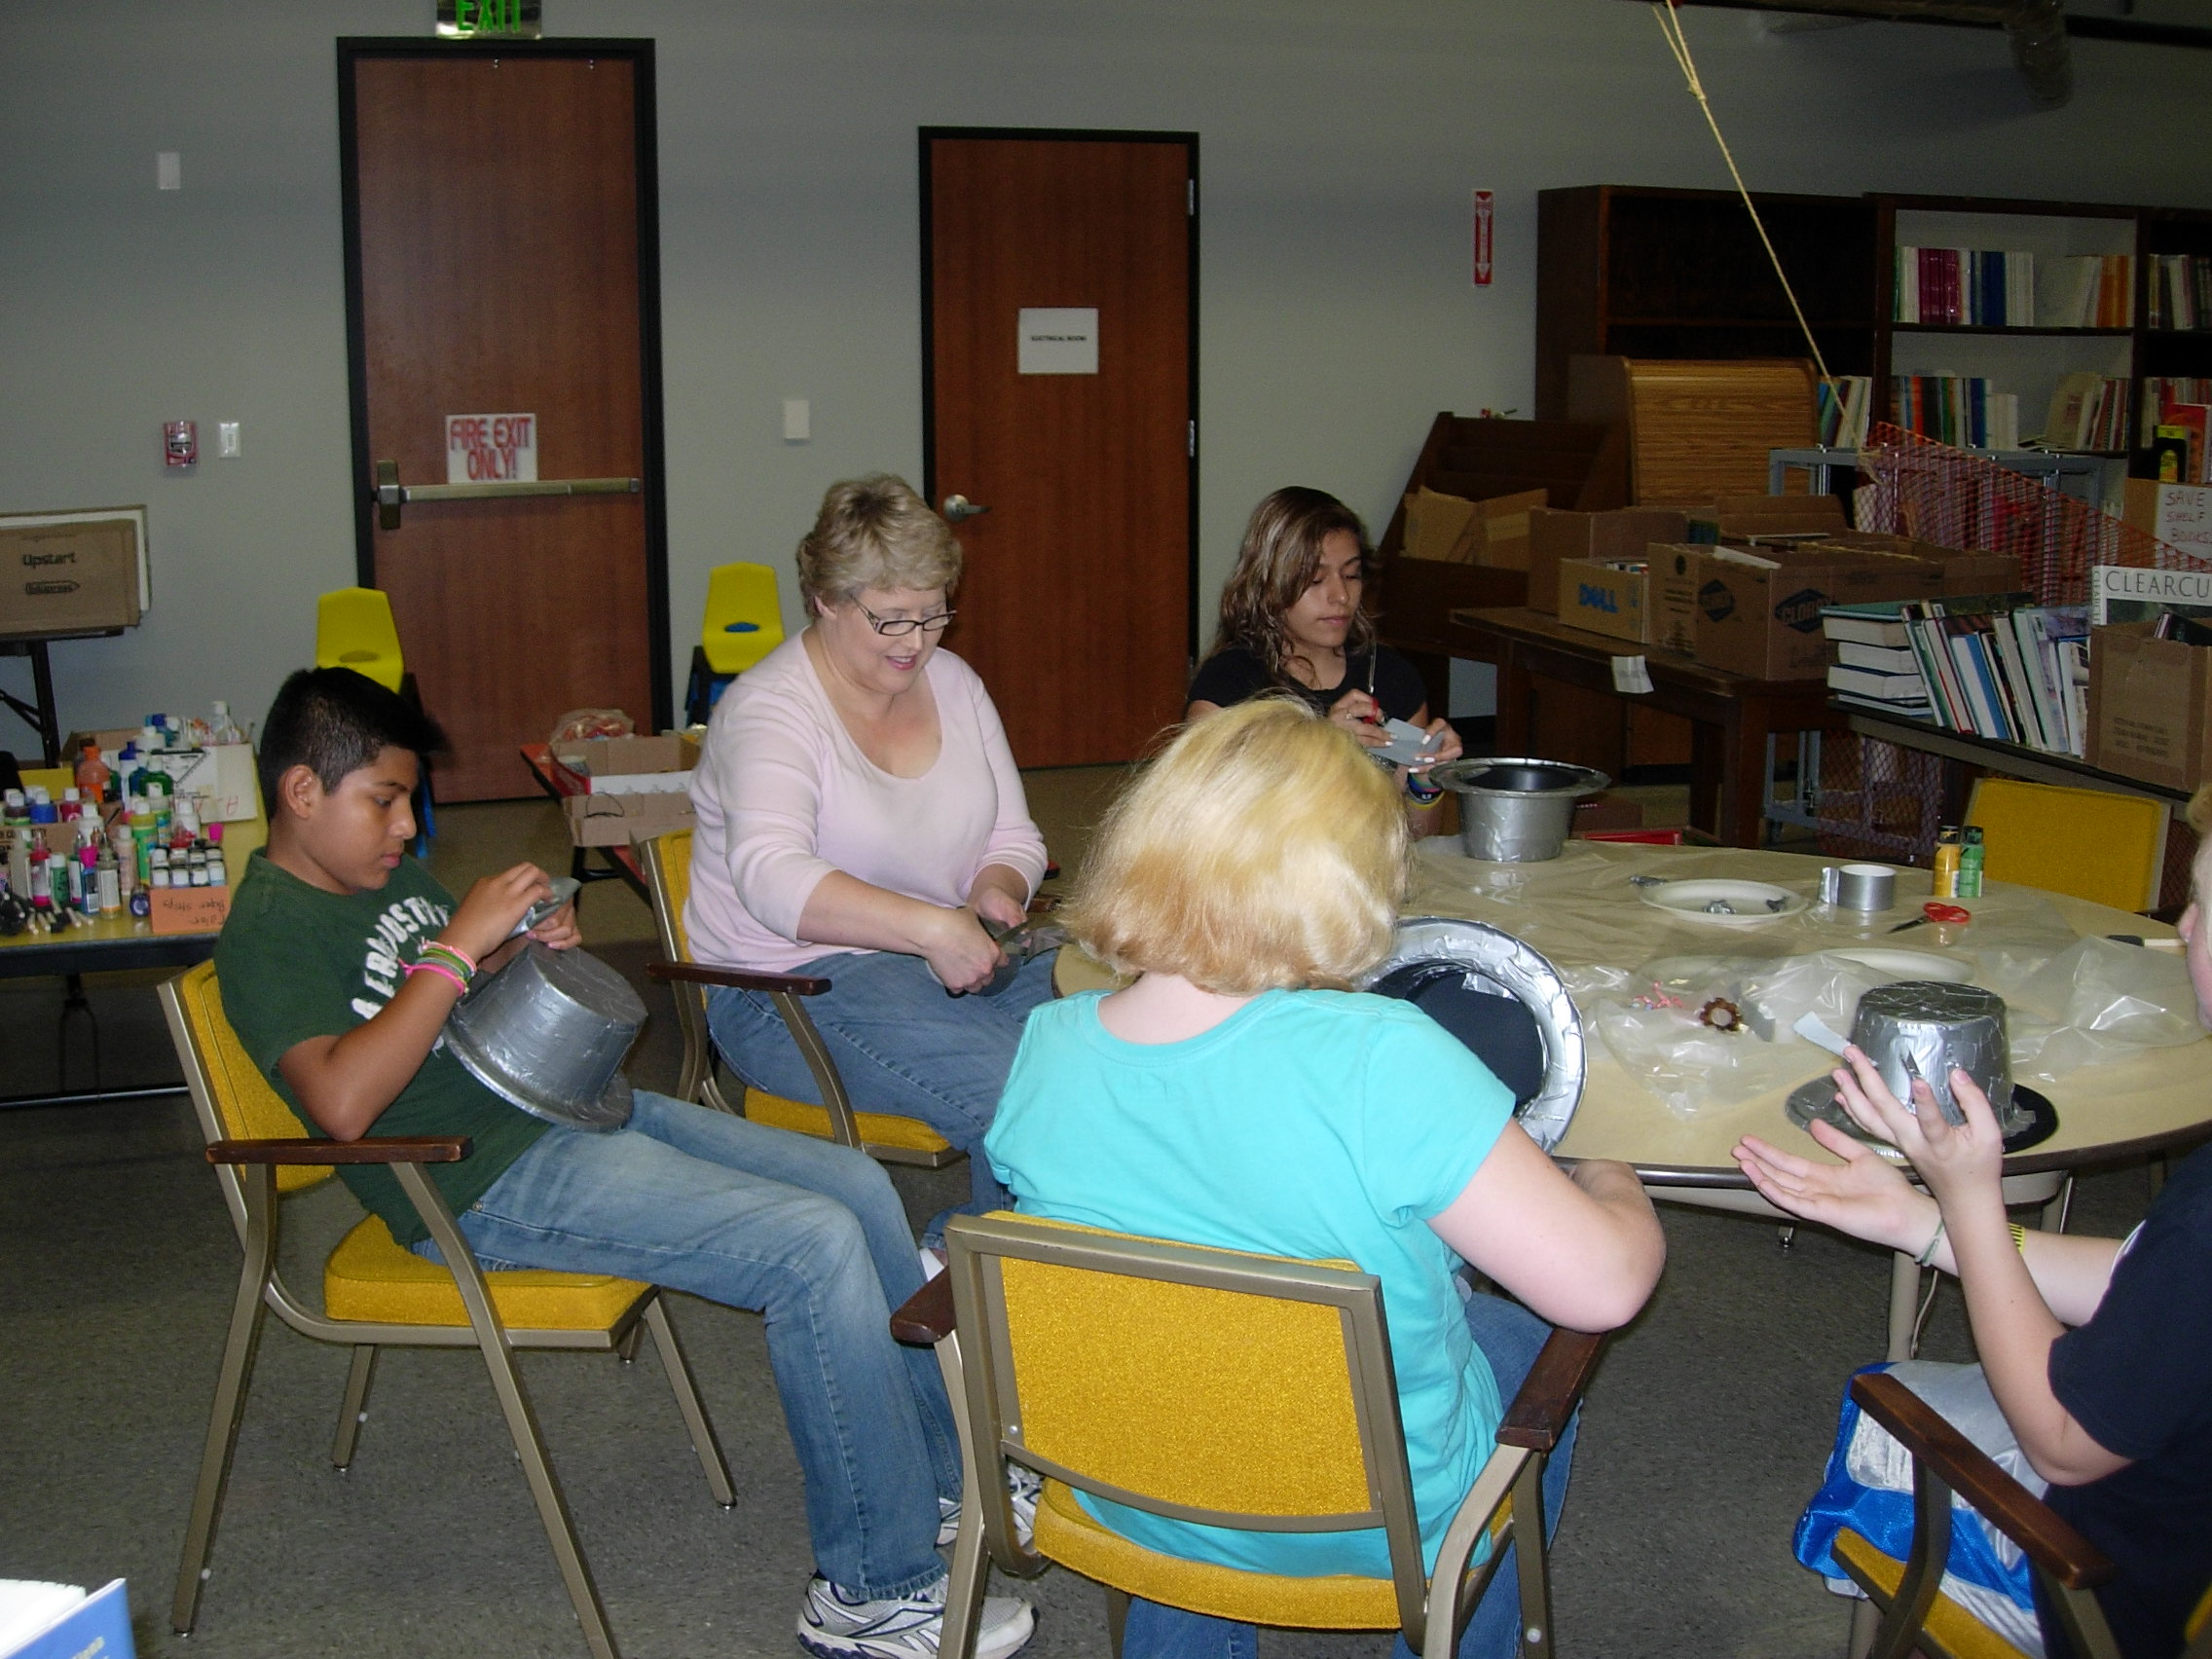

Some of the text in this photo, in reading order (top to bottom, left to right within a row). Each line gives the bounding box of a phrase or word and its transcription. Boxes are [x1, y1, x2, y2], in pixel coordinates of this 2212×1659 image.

[451, 418, 531, 451] FIRE EXIT
[1578, 583, 1620, 614] DELL
